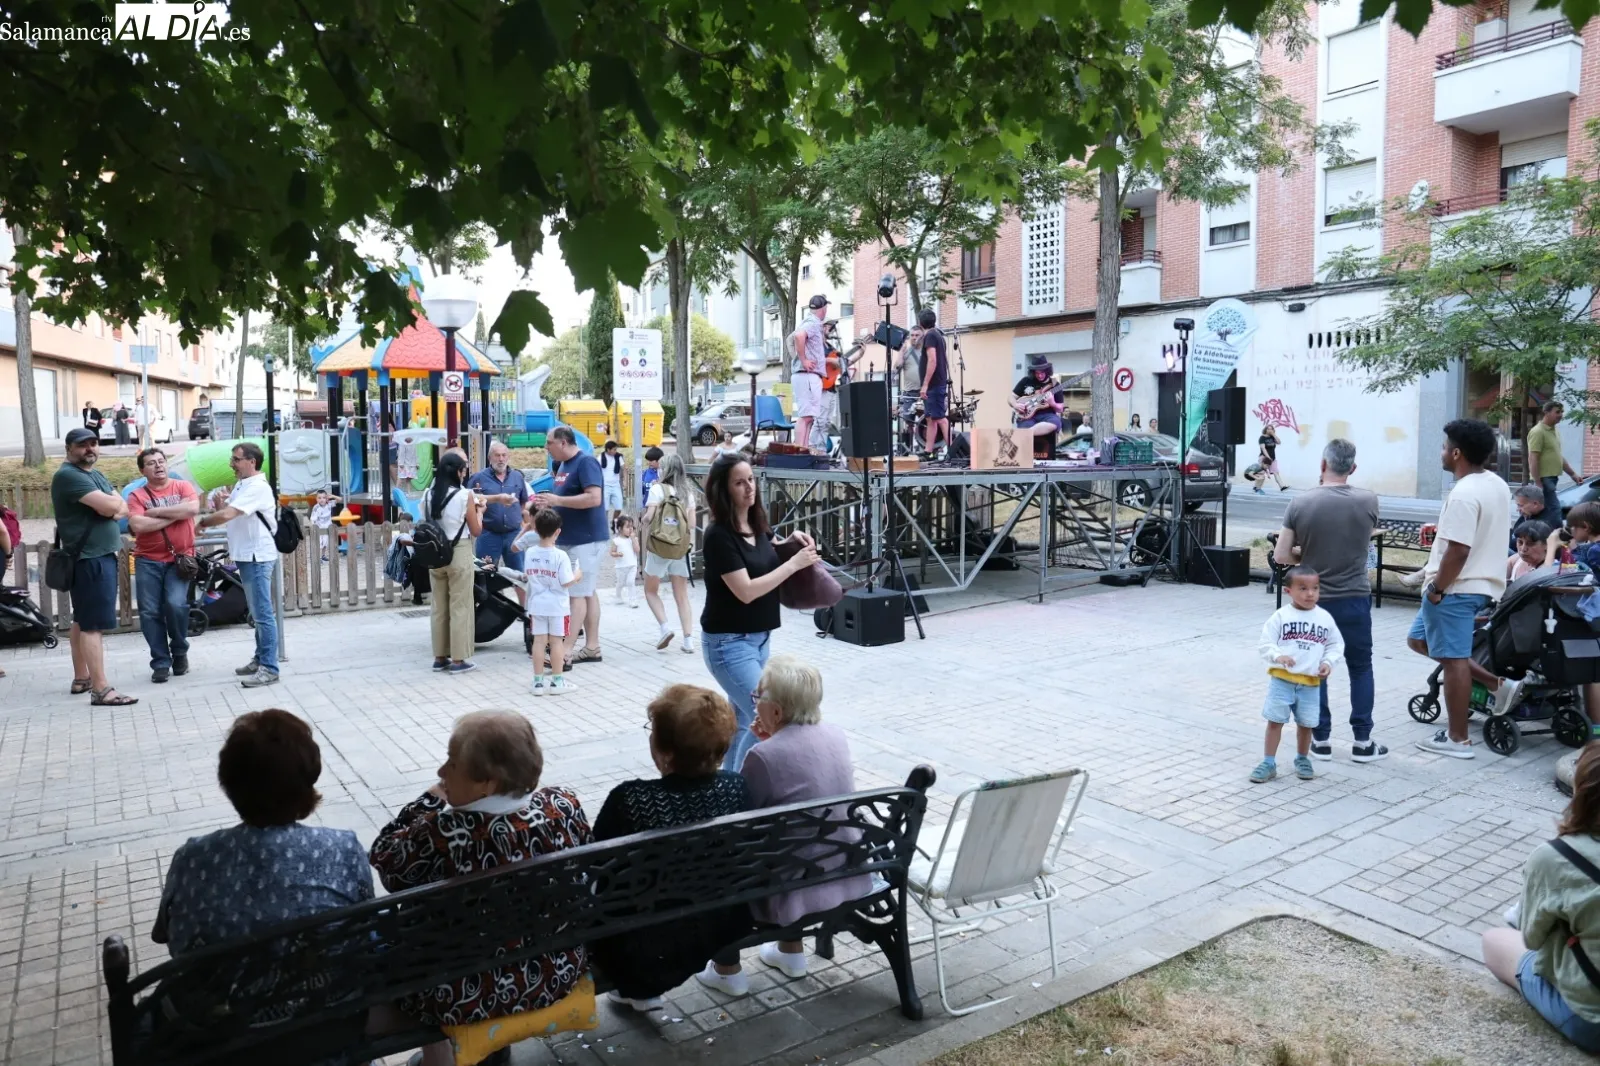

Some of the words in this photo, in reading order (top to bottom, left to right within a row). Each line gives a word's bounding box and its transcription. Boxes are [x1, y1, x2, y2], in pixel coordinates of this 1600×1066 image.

[1203, 350, 1239, 360] Aldehuela
[1202, 357, 1234, 367] Salamanca
[540, 568, 557, 579] YORK
[1282, 621, 1329, 640] CHICAGO
